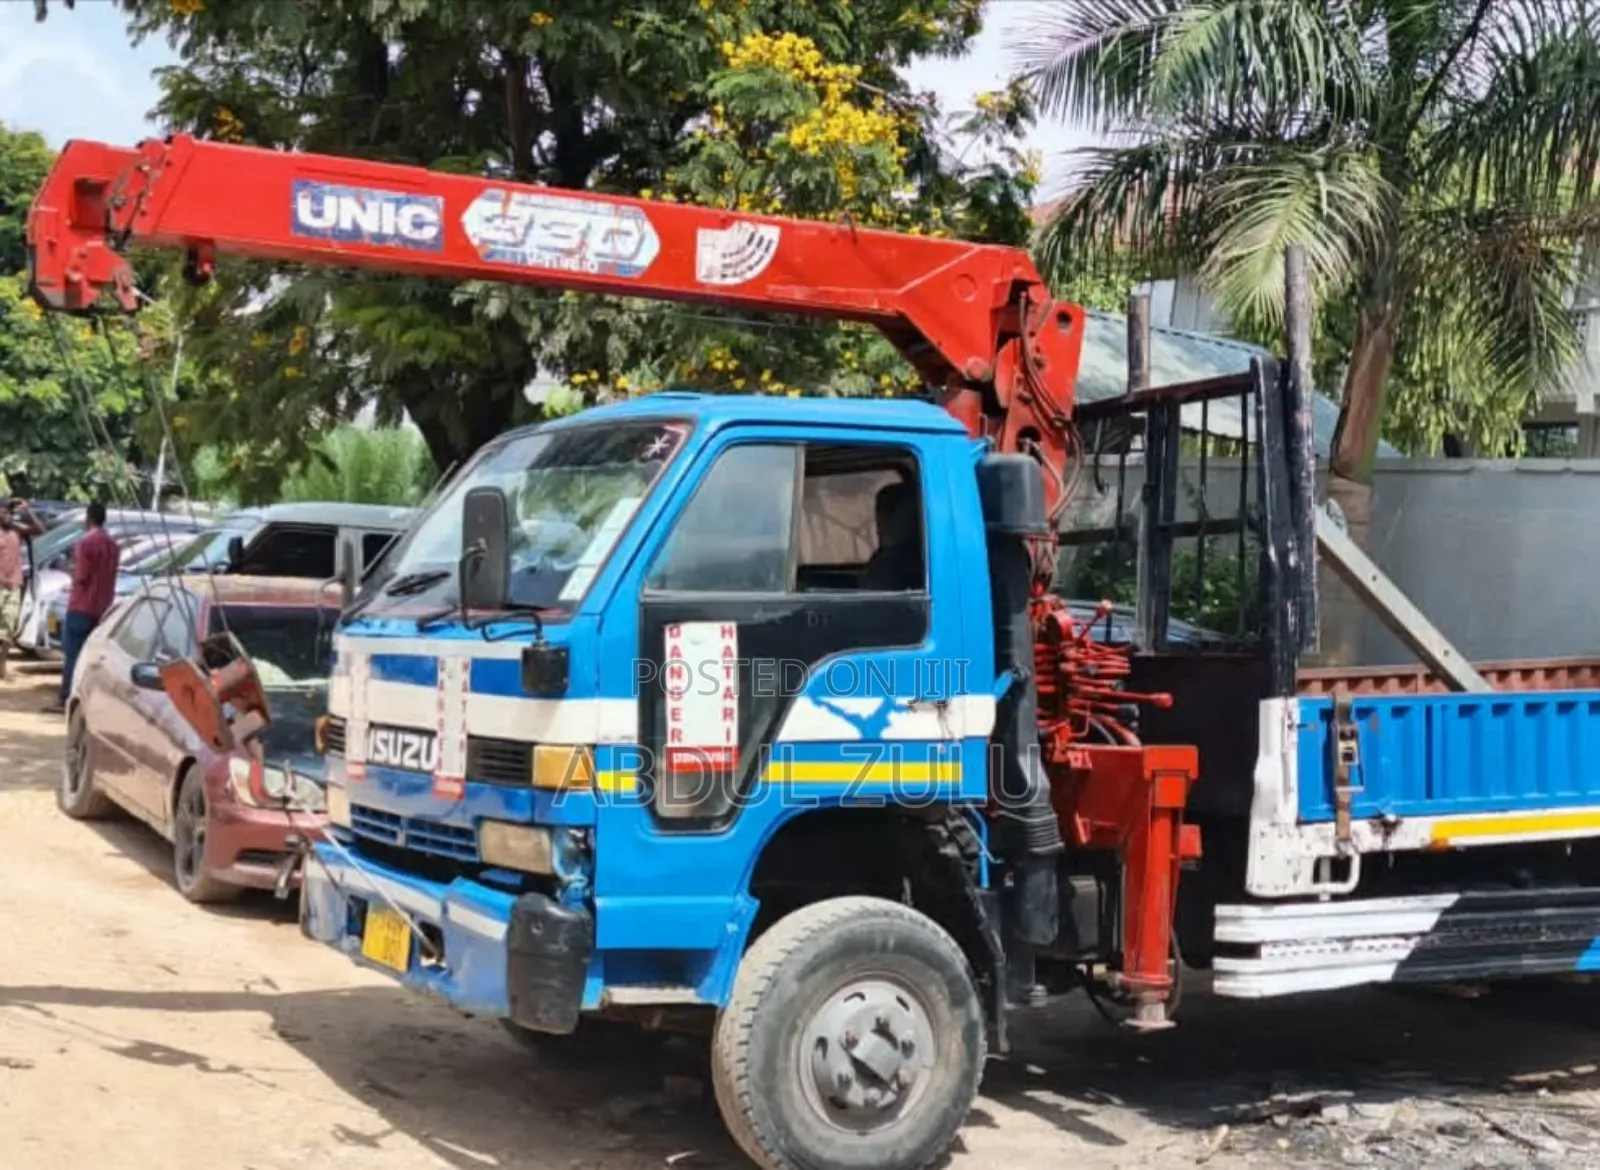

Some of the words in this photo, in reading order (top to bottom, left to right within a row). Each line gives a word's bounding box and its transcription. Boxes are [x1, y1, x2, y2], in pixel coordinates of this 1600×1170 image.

[297, 190, 440, 240] UNIC
[669, 625, 682, 743] DANGER
[720, 625, 735, 743] HATARI
[368, 729, 438, 772] ISUZU
